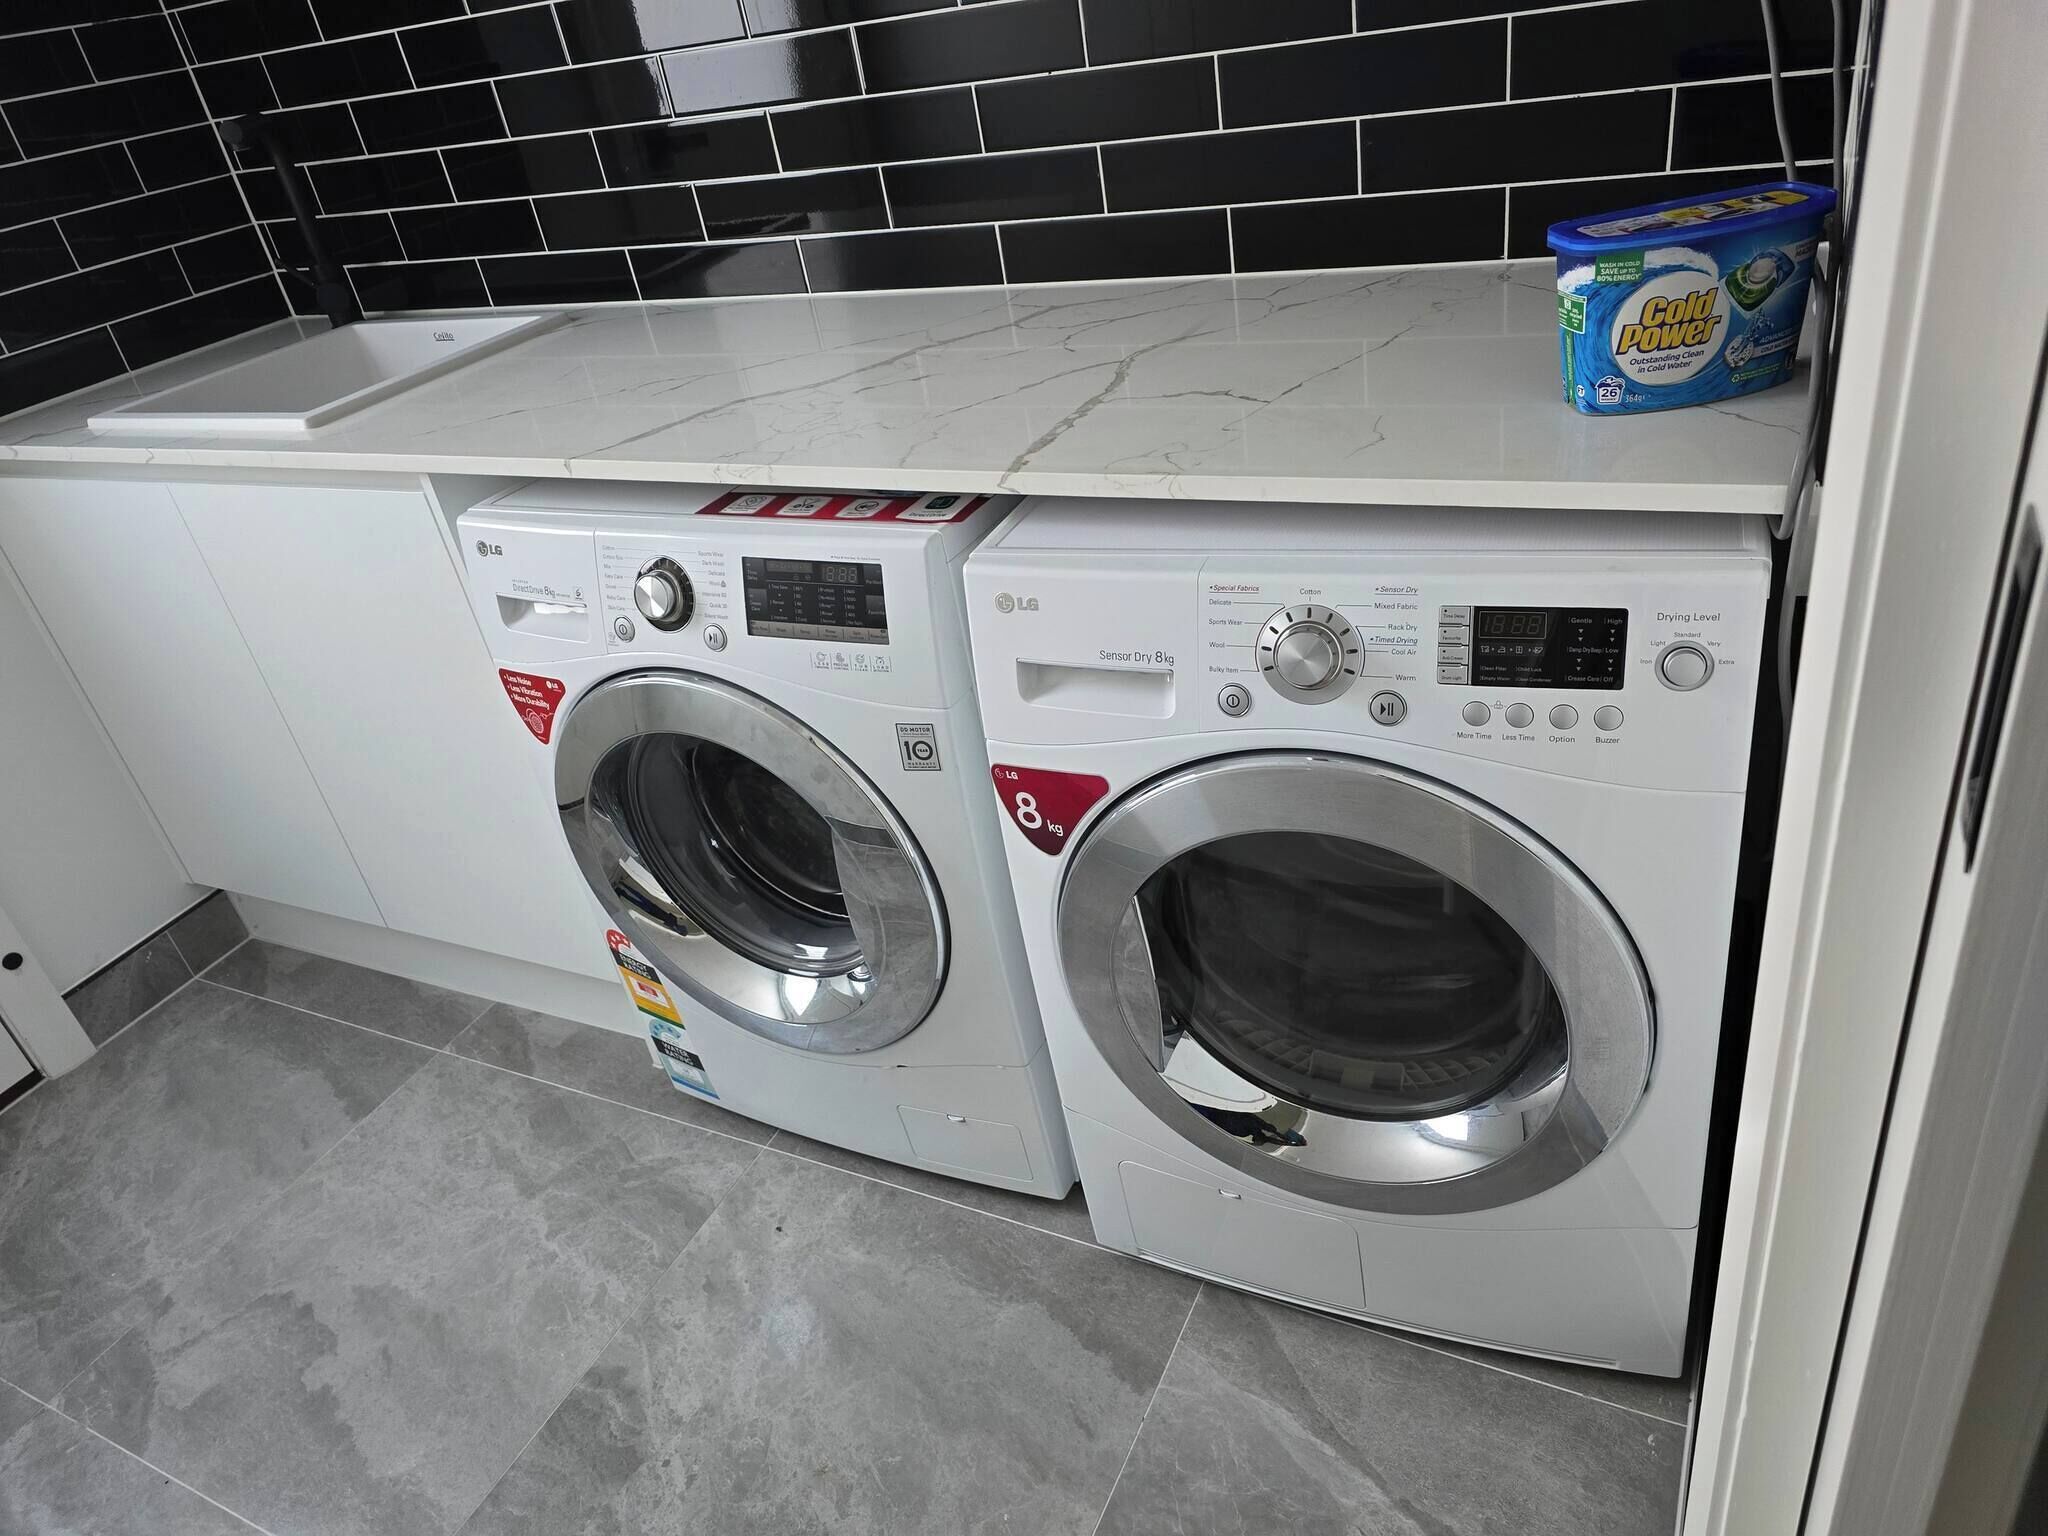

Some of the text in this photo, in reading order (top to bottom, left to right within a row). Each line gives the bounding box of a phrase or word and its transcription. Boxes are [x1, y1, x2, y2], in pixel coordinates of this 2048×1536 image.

[1640, 286, 1720, 327] Cold
[1616, 314, 1722, 355] Power
[1630, 350, 1704, 366] Outstanding Clean
[1637, 360, 1693, 374] in Cold Water
[1601, 388, 1618, 398] 26
[1213, 584, 1236, 592] Special
[1656, 612, 1721, 624] Drying Level
[1405, 624, 1418, 632] Dry
[1394, 637, 1418, 646] Drying
[1099, 650, 1132, 662] Sensor
[1134, 652, 1152, 664] Dry
[1475, 732, 1492, 740] Time
[1502, 733, 1518, 741] Less
[1548, 736, 1576, 744] Option
[1596, 736, 1620, 744] Buzzer
[904, 740, 934, 760] 10
[1015, 792, 1042, 829] 8
[1047, 819, 1064, 836] kg
